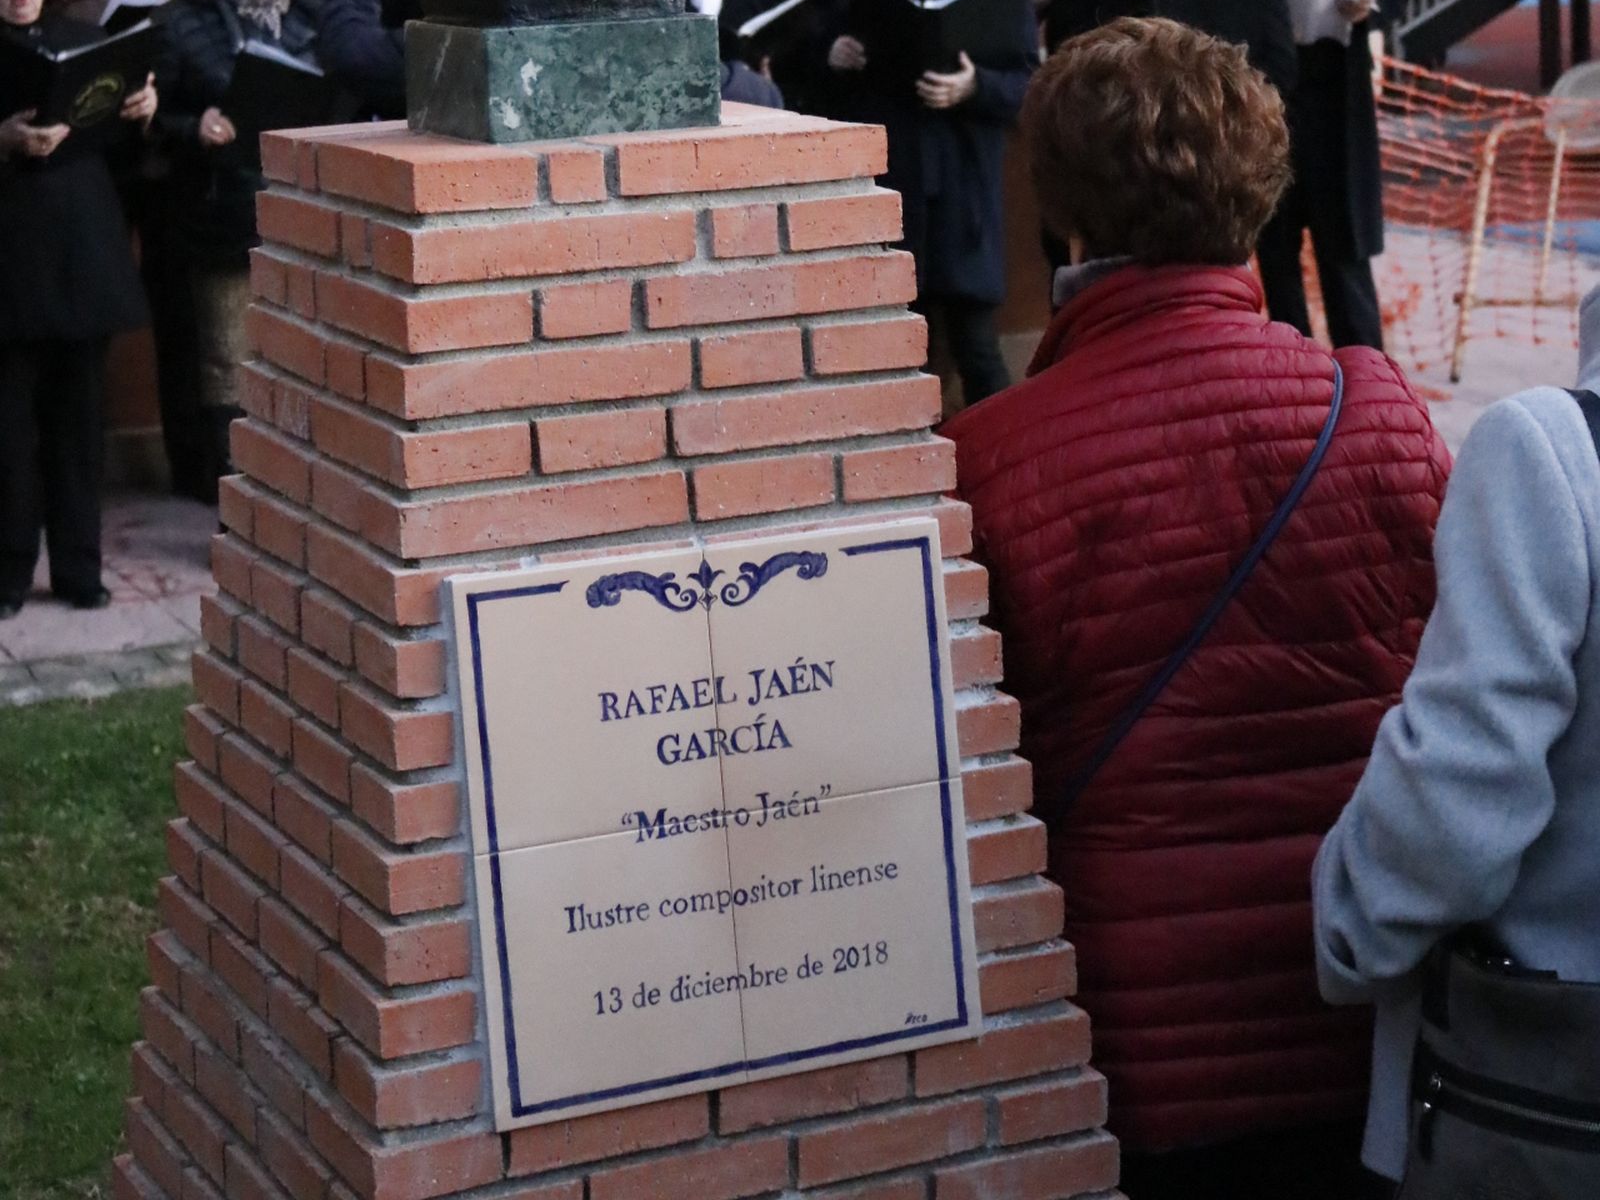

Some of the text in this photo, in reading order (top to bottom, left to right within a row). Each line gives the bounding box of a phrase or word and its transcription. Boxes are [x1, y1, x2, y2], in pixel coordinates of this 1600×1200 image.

[598, 657, 835, 722] RAFAEL JAÉN
[656, 713, 793, 765] GARCÍA
[621, 784, 832, 843] “Maestro Jaén”
[564, 861, 898, 933] Ilustre compositor linense
[594, 941, 889, 1016] 13 de diciembre de 2018
